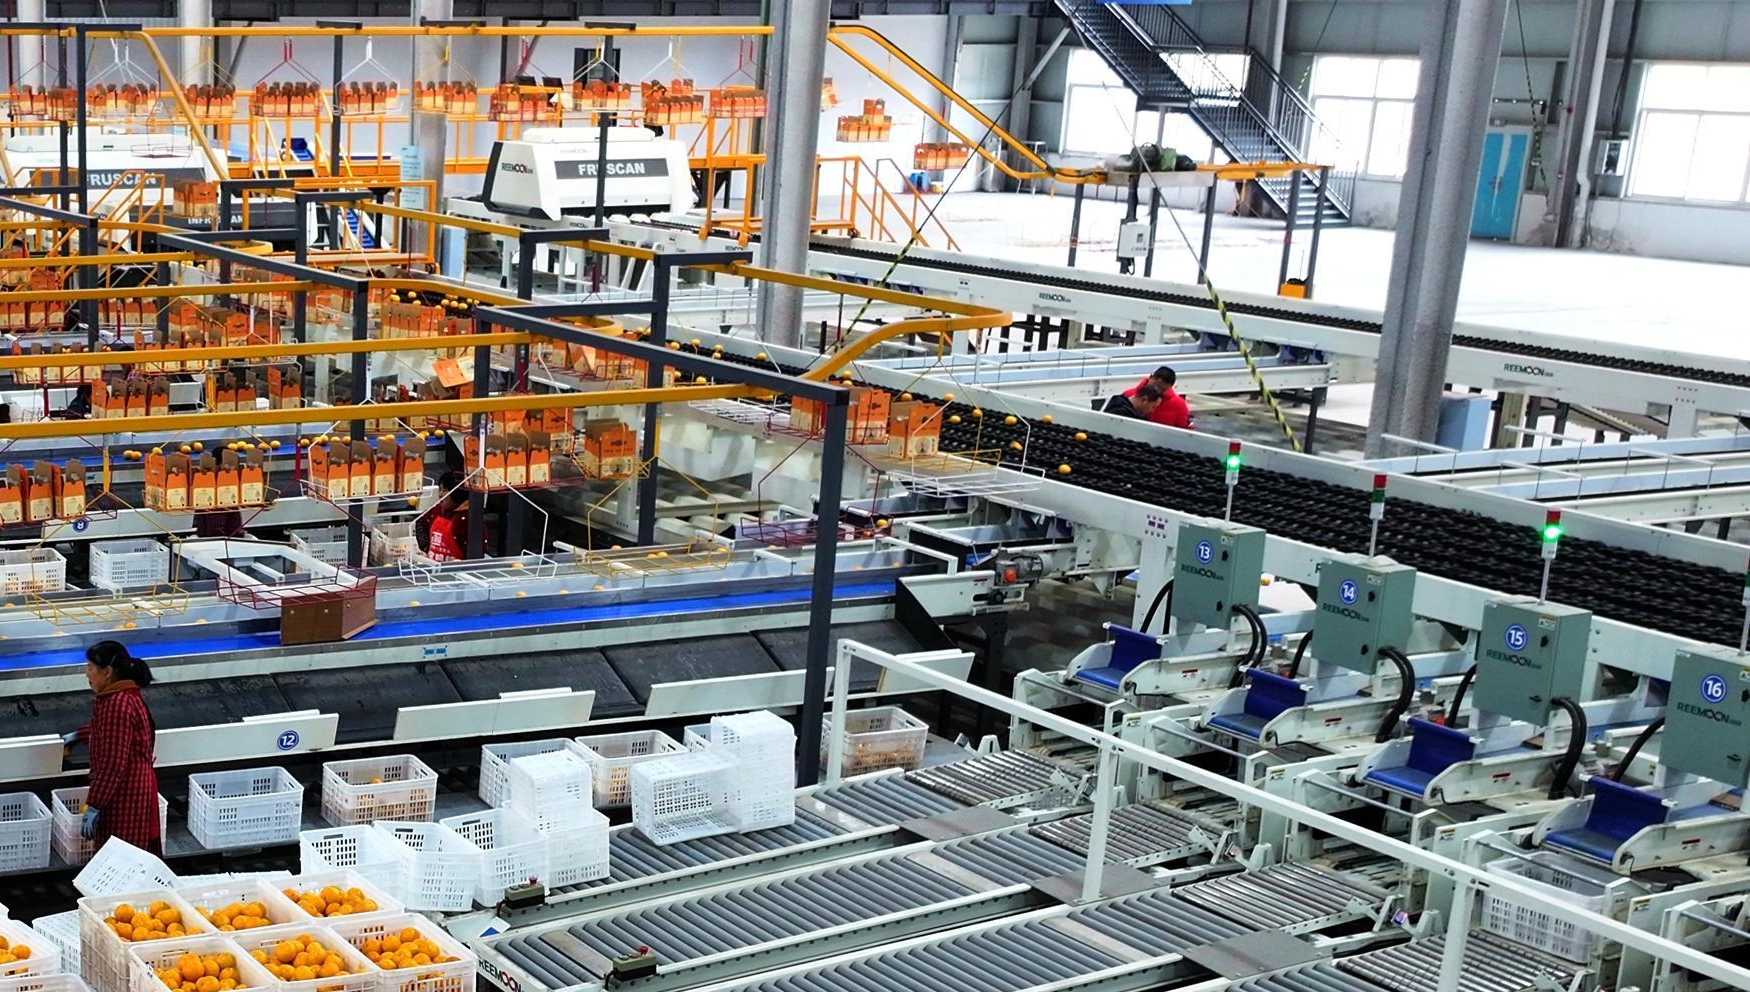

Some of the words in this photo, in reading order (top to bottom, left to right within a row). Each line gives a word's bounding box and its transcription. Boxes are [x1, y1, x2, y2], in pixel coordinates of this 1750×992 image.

[578, 163, 645, 175] FRSCAN
[1503, 363, 1545, 376] REEMOON
[1199, 545, 1210, 559] 13
[1343, 584, 1355, 600] 14
[1511, 630, 1523, 645] 15
[1486, 650, 1532, 668] REEMOON
[1707, 680, 1722, 697] 16
[1677, 701, 1730, 723] REEMOON
[282, 735, 295, 747] 12
